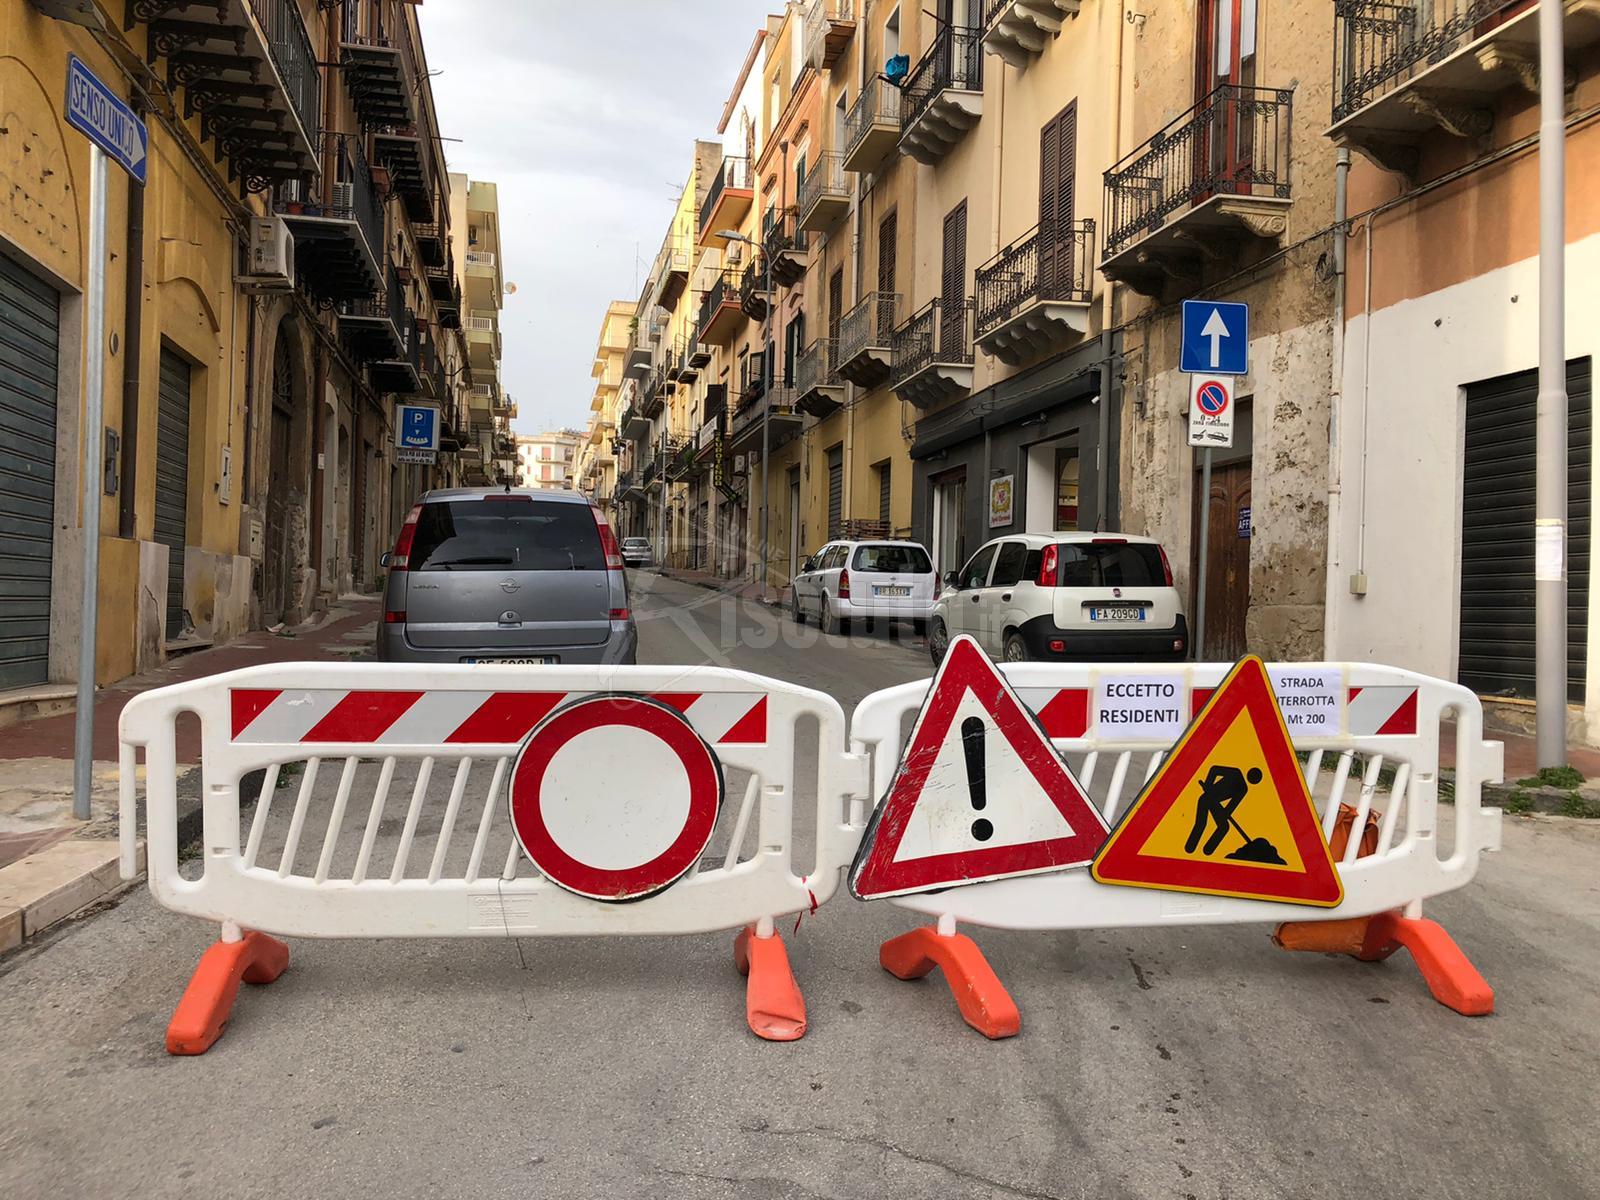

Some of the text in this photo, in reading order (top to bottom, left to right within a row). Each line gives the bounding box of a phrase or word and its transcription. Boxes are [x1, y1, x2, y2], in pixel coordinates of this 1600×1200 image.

[72, 74, 106, 131] SENSO
[414, 413, 423, 424] P
[1280, 677, 1324, 689] STRADA
[1106, 683, 1175, 698] ECCETTO
[1099, 708, 1179, 724] RESIDENTI
[1287, 712, 1326, 725] Mt 200
